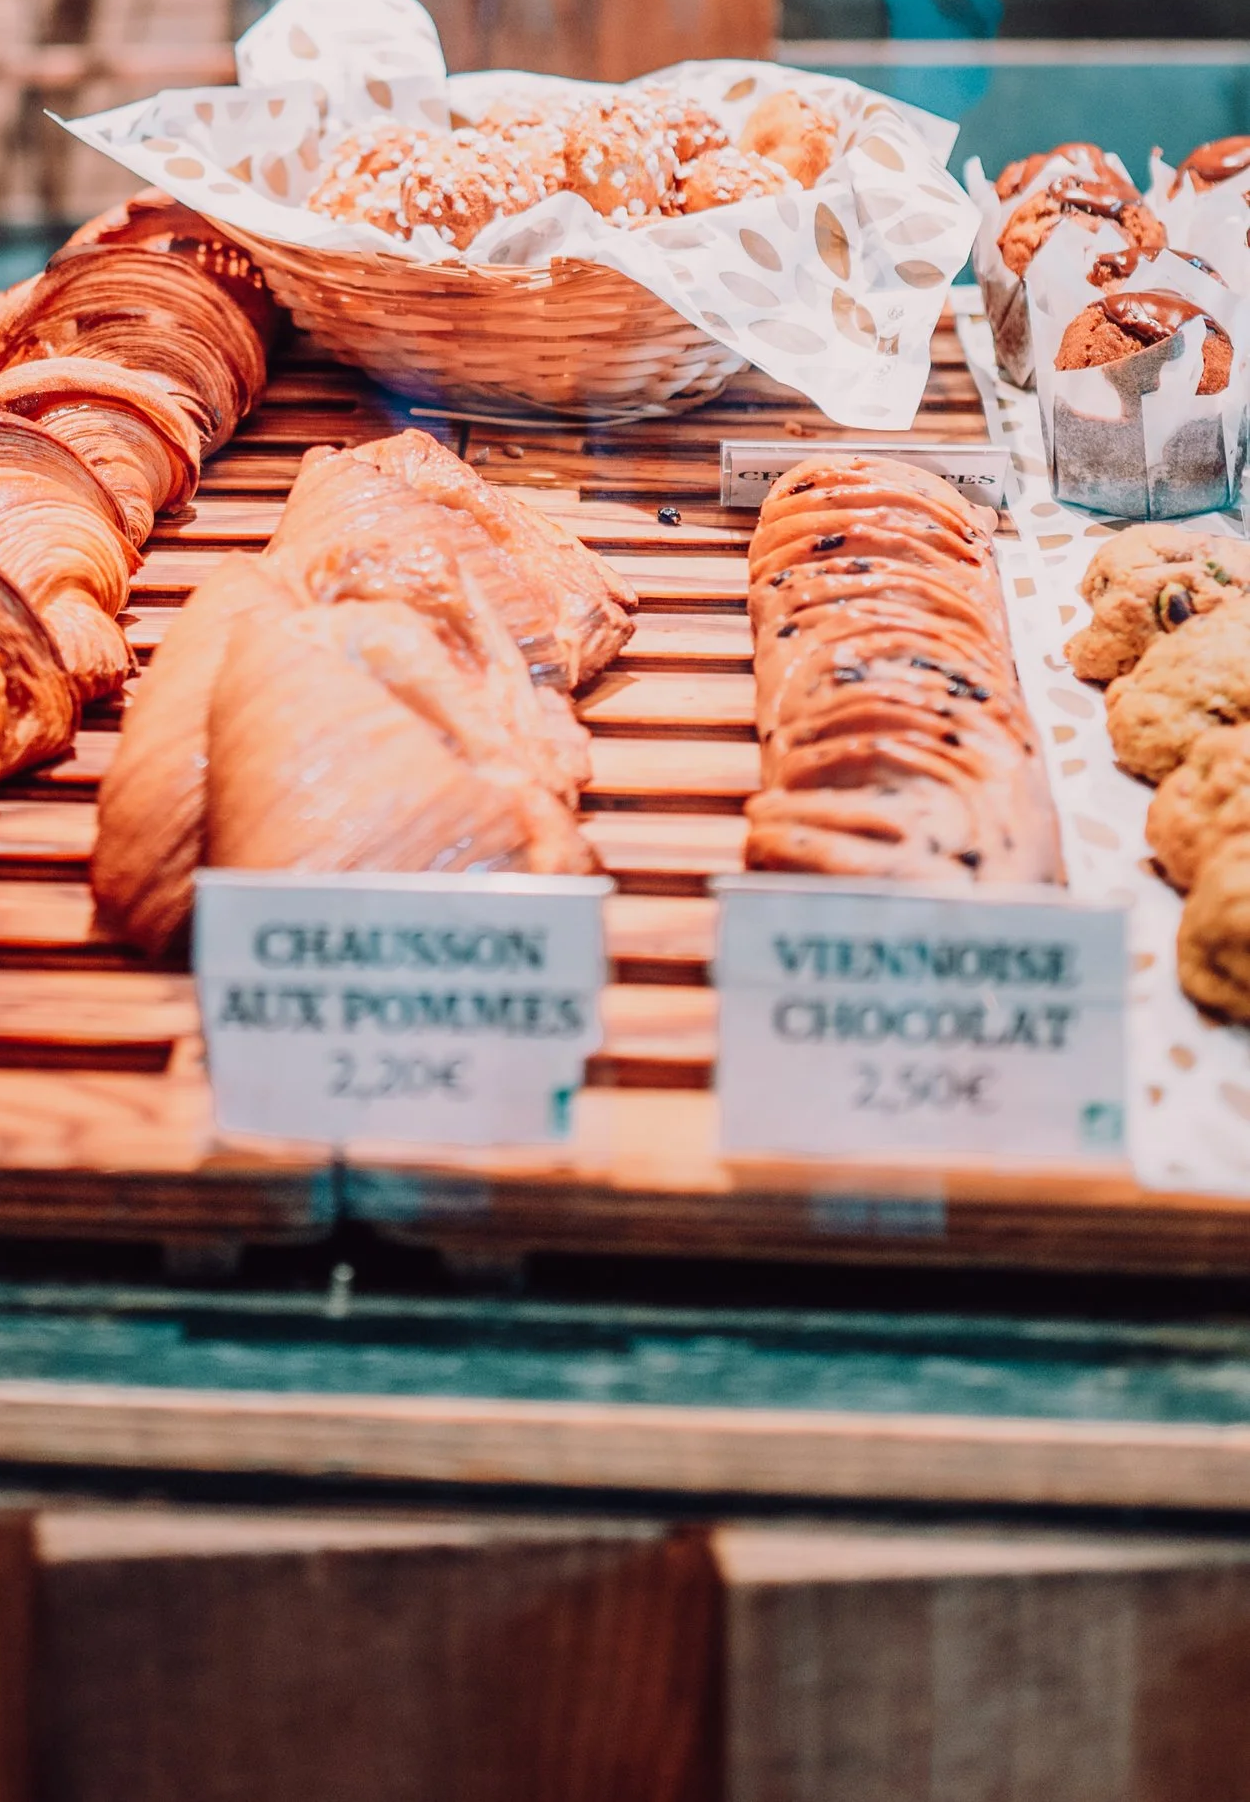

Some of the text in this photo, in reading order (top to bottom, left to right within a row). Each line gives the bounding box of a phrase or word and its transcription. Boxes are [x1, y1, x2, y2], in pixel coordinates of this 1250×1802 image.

[253, 919, 546, 970] CHAUSSON
[772, 935, 1078, 986] VIENNOISE
[219, 983, 585, 1039] AUX POMMES
[771, 998, 1073, 1051] CHOCOLAT
